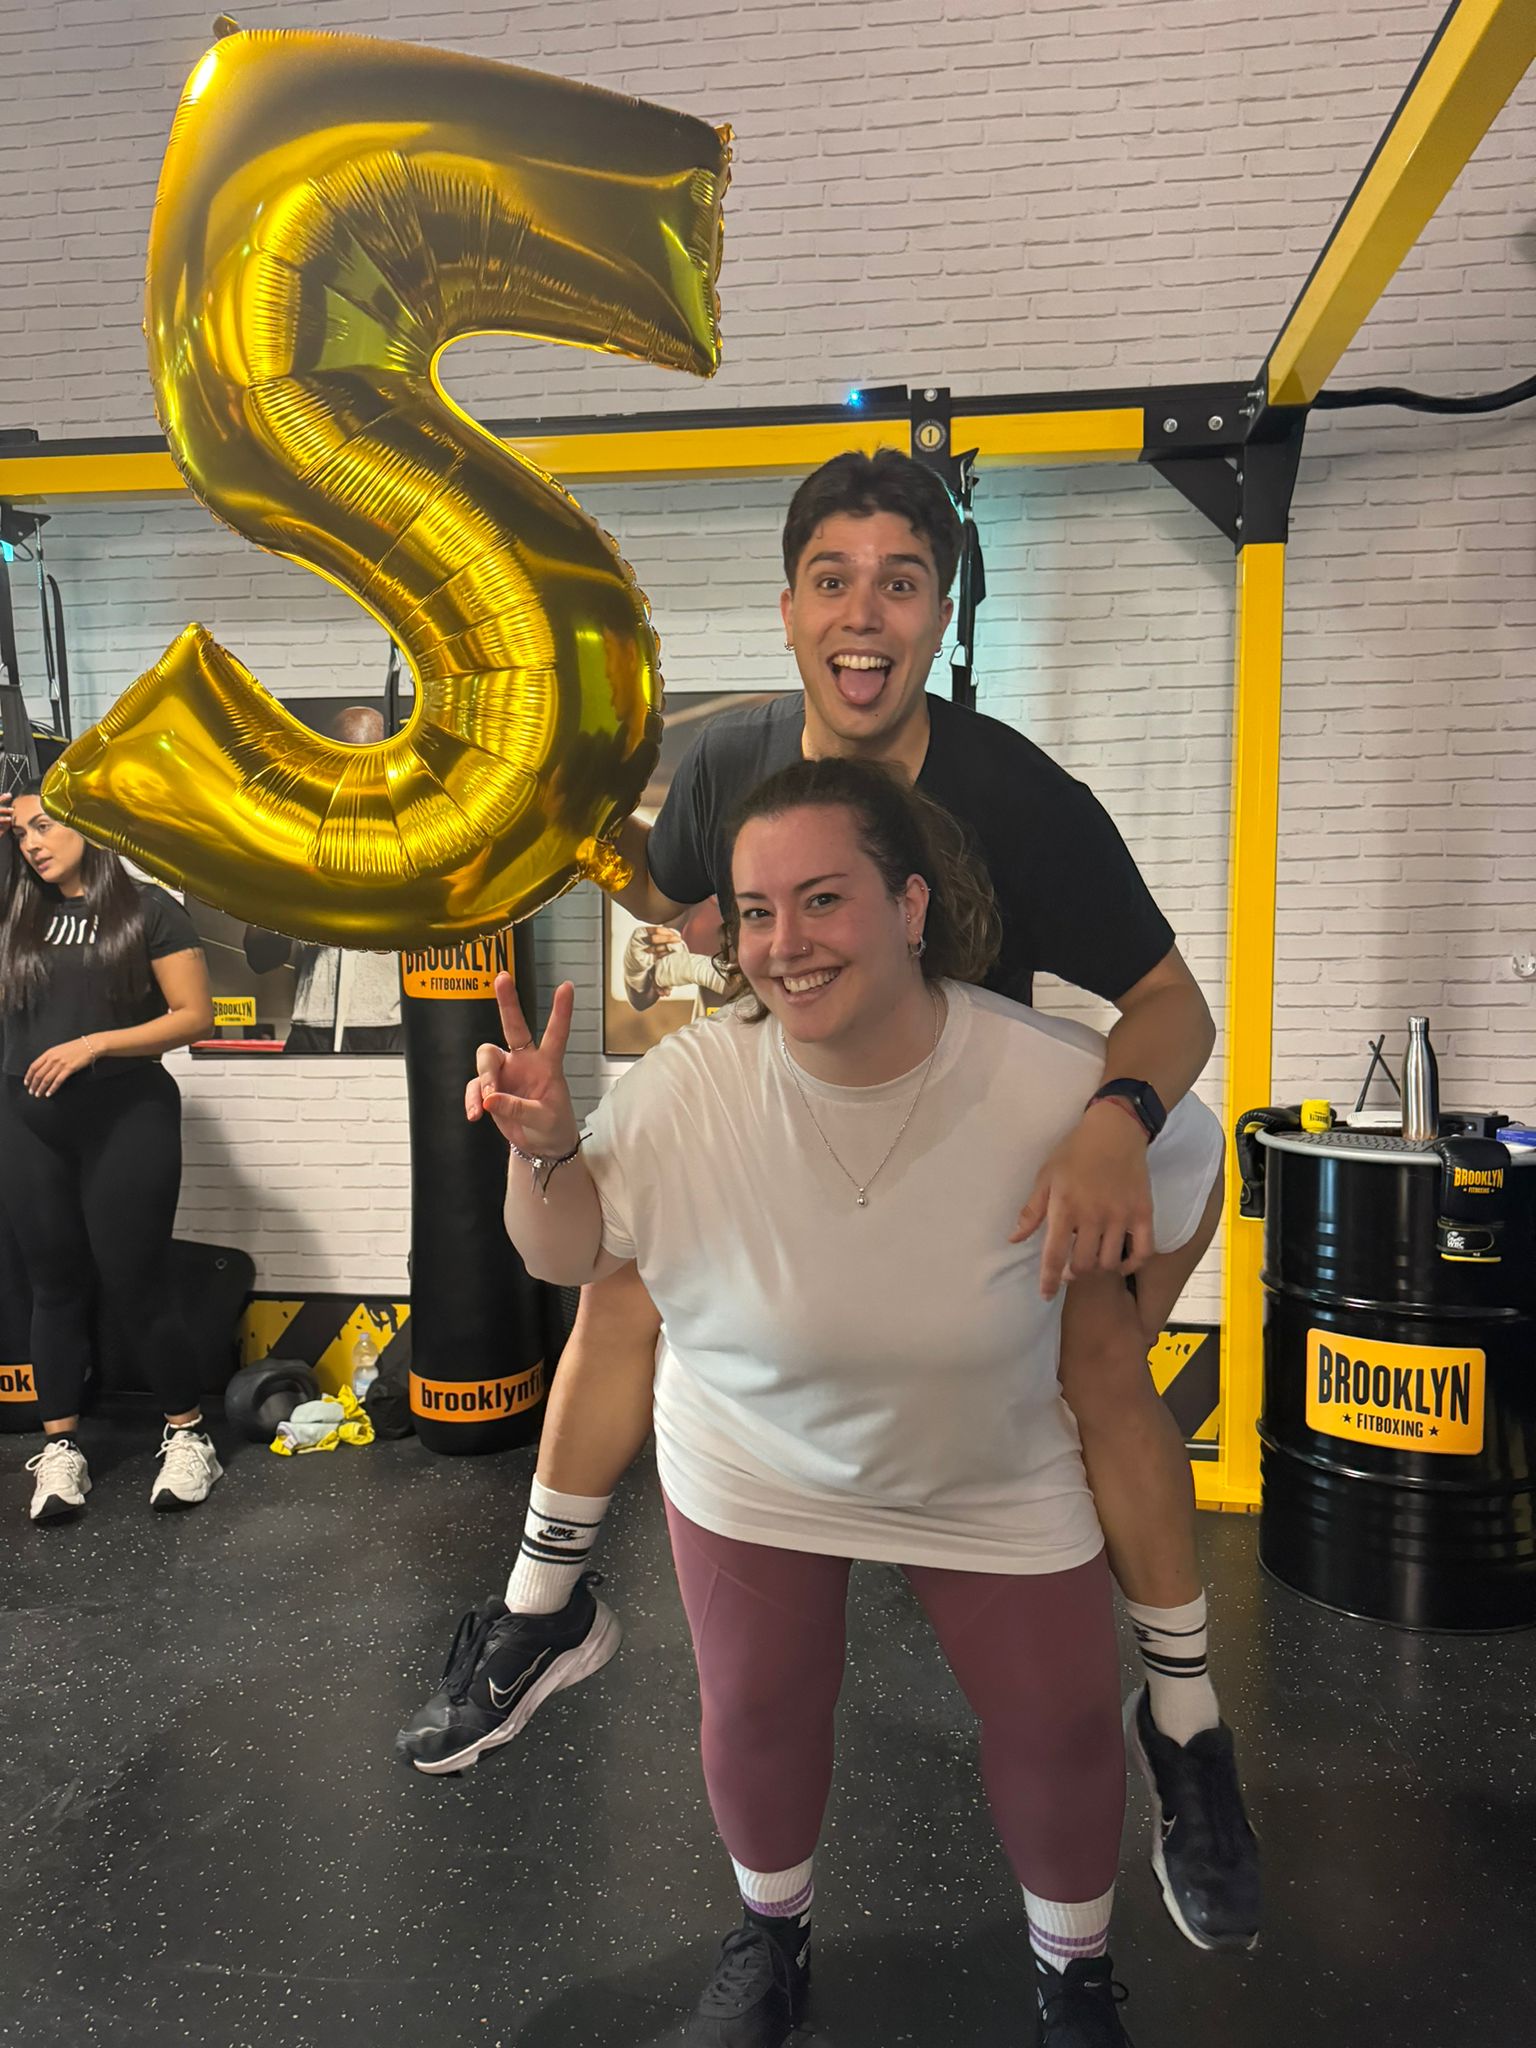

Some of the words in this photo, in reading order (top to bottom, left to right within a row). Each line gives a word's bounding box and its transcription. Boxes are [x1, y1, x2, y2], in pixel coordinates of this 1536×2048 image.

[927, 429, 933, 444] 1
[430, 978, 479, 991] FITBOXING
[213, 1001, 253, 1018] BROOKLYN
[1453, 1166, 1504, 1189] BROOKLYN
[1318, 1343, 1470, 1425] BROOKLYN
[1356, 1412, 1424, 1438] FITBOXING
